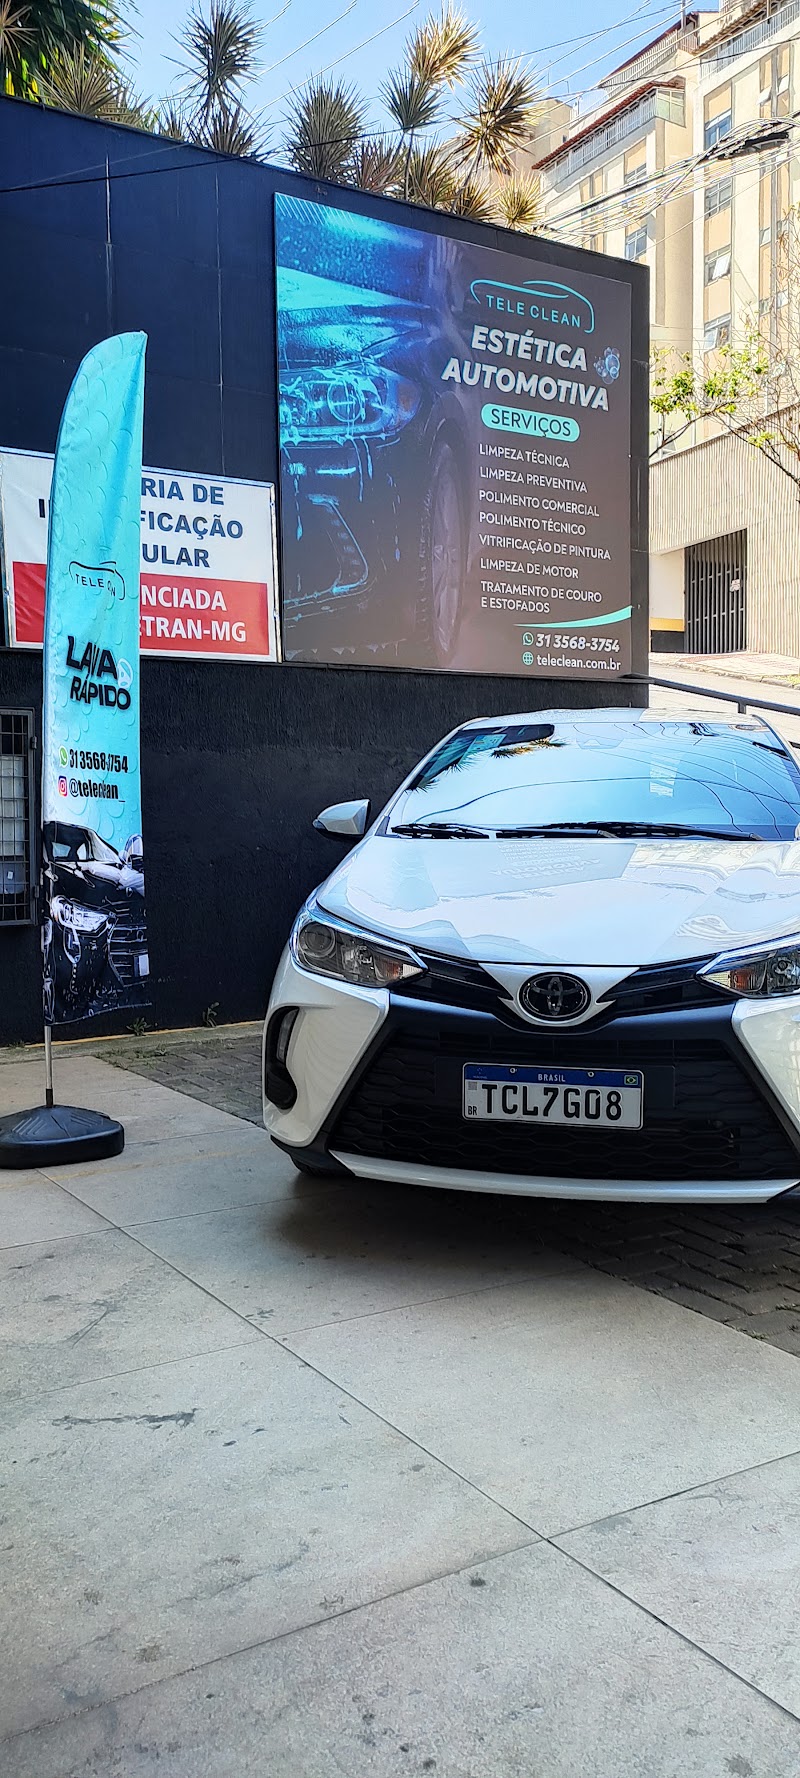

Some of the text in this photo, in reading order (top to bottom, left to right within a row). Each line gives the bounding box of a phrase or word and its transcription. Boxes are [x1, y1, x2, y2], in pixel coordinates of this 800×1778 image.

[486, 295, 581, 328] TELE CLEAN
[471, 324, 588, 372] ESTÉTICA
[441, 357, 610, 412] AUTOMOTIVA
[491, 408, 571, 438] SERVIÇOS
[479, 443, 570, 468] LIMPEZA TÉCNICA
[141, 477, 225, 506] RIA DE
[480, 466, 588, 493] LIMPEZA PREVENTIVA
[479, 490, 600, 517] POLIMENTO COMERCIAL
[479, 512, 586, 536] POLIMENTO TÉCNICO
[142, 543, 211, 568] ULAR
[479, 534, 611, 560] VITRIFICAÇÃO DE PINTURA
[75, 573, 105, 588] TELE
[480, 558, 579, 579] LIMPEZA DE MOTOR
[141, 584, 228, 612] NCIADA
[481, 580, 602, 603] TRATAMENTO DE COURO
[481, 597, 550, 613] E ESTOFADOS
[139, 615, 247, 643] TRAN-MG
[535, 633, 621, 653] 31 3568-3754
[66, 635, 118, 680] LAVA
[537, 654, 621, 671] teleclean.com.br
[70, 673, 131, 710] RÁPIDO
[69, 748, 78, 769] 31
[537, 1073, 566, 1083] BRASIL
[467, 1105, 478, 1117] BR
[481, 1083, 622, 1121] TCL7G08
